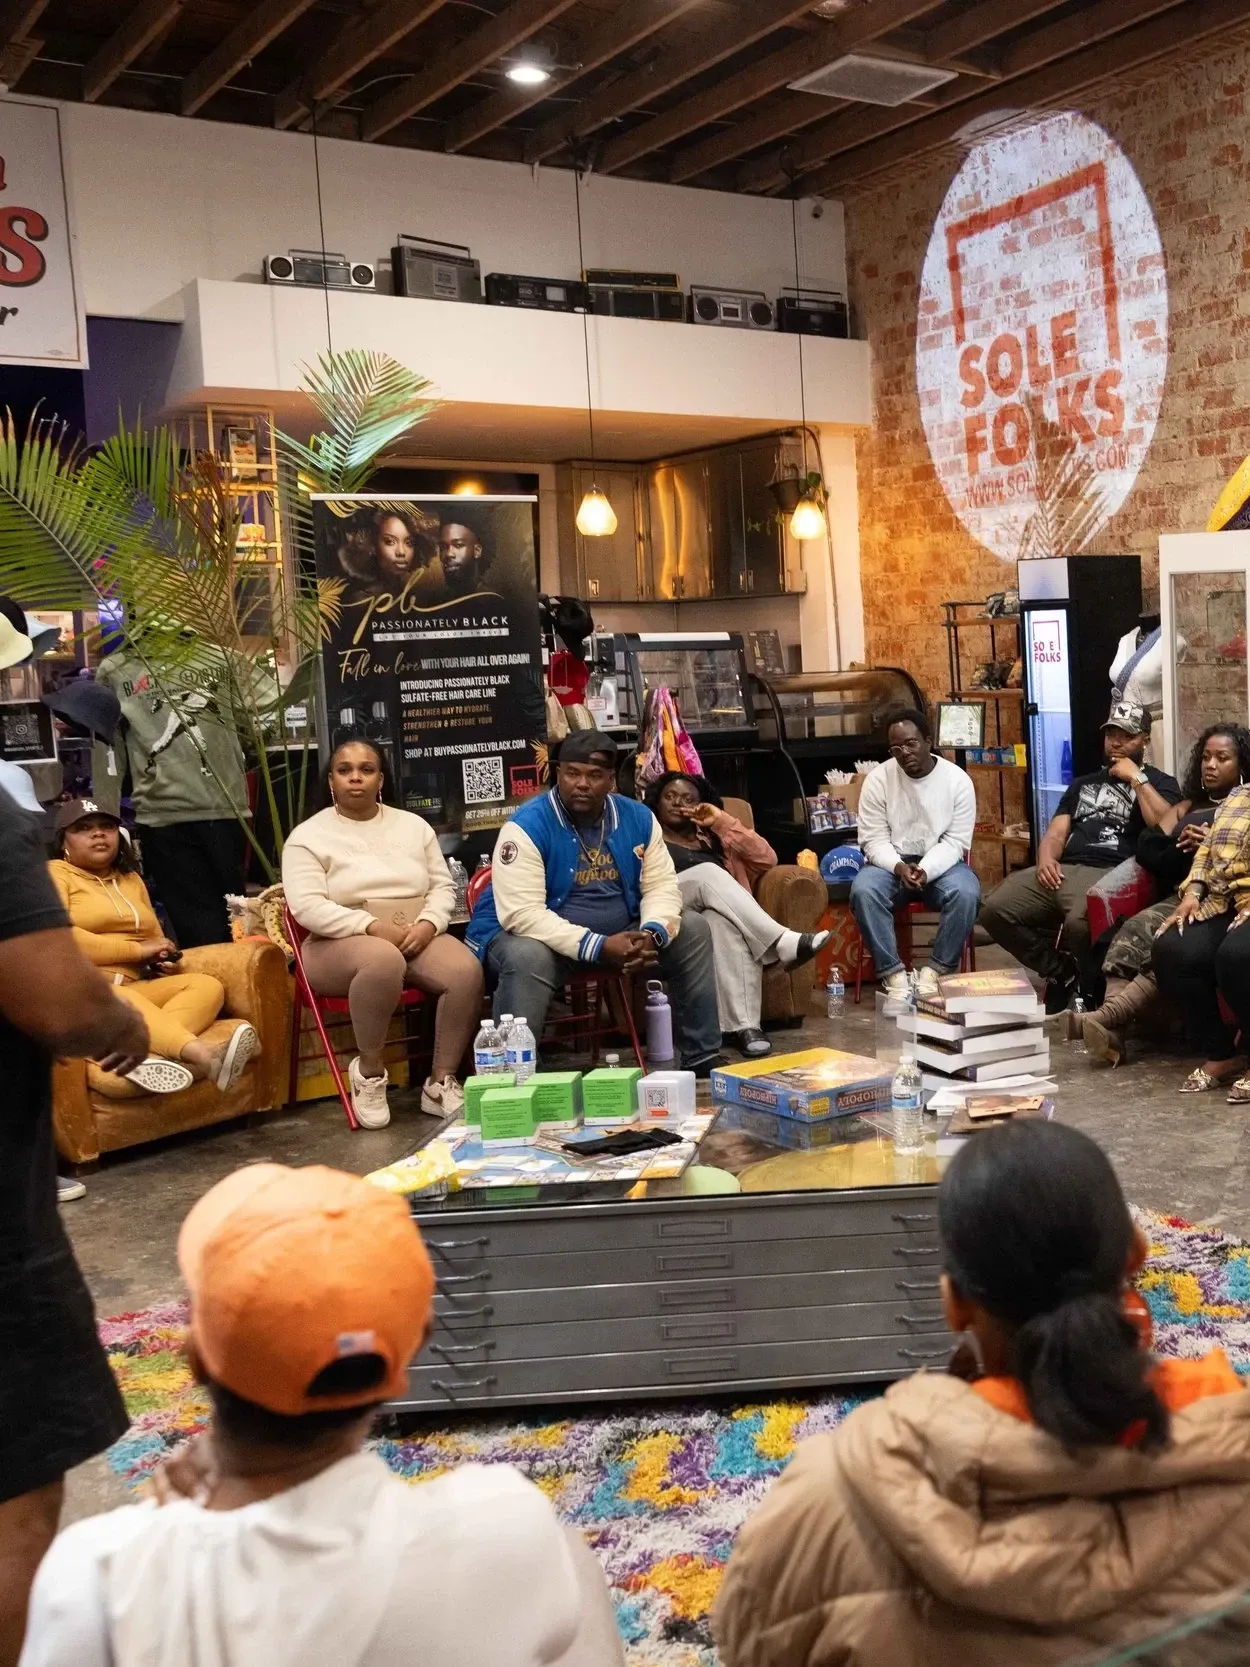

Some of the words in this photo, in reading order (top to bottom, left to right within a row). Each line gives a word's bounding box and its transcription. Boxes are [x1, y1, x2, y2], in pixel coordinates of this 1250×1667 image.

[959, 310, 1080, 408] SOLE
[371, 618, 458, 631] PASSIONATELY
[462, 615, 509, 627] BLACK
[337, 647, 371, 684] Fall
[373, 662, 390, 675] in
[394, 651, 421, 676] love
[420, 658, 440, 670] WITH
[441, 657, 460, 669] YOUR
[460, 656, 476, 668] HAIR
[477, 656, 489, 667] ALL
[489, 654, 508, 666] OVER
[508, 653, 530, 665] AGAIN!
[1034, 652, 1062, 663] FOLKS
[400, 679, 444, 691] INTRODUCING
[444, 676, 489, 688] PASSIONATELY
[490, 674, 510, 685] BLACK
[401, 692, 448, 703] SULFATE-FREE
[448, 689, 464, 700] HAIR
[465, 689, 481, 699] CARE
[482, 688, 497, 698] LINE
[441, 706, 455, 716] WAY
[405, 748, 423, 759] SHOP
[423, 748, 432, 758] AT
[433, 739, 526, 757] BUYPASSIONATELYBLACK.COM
[81, 799, 98, 812] LA
